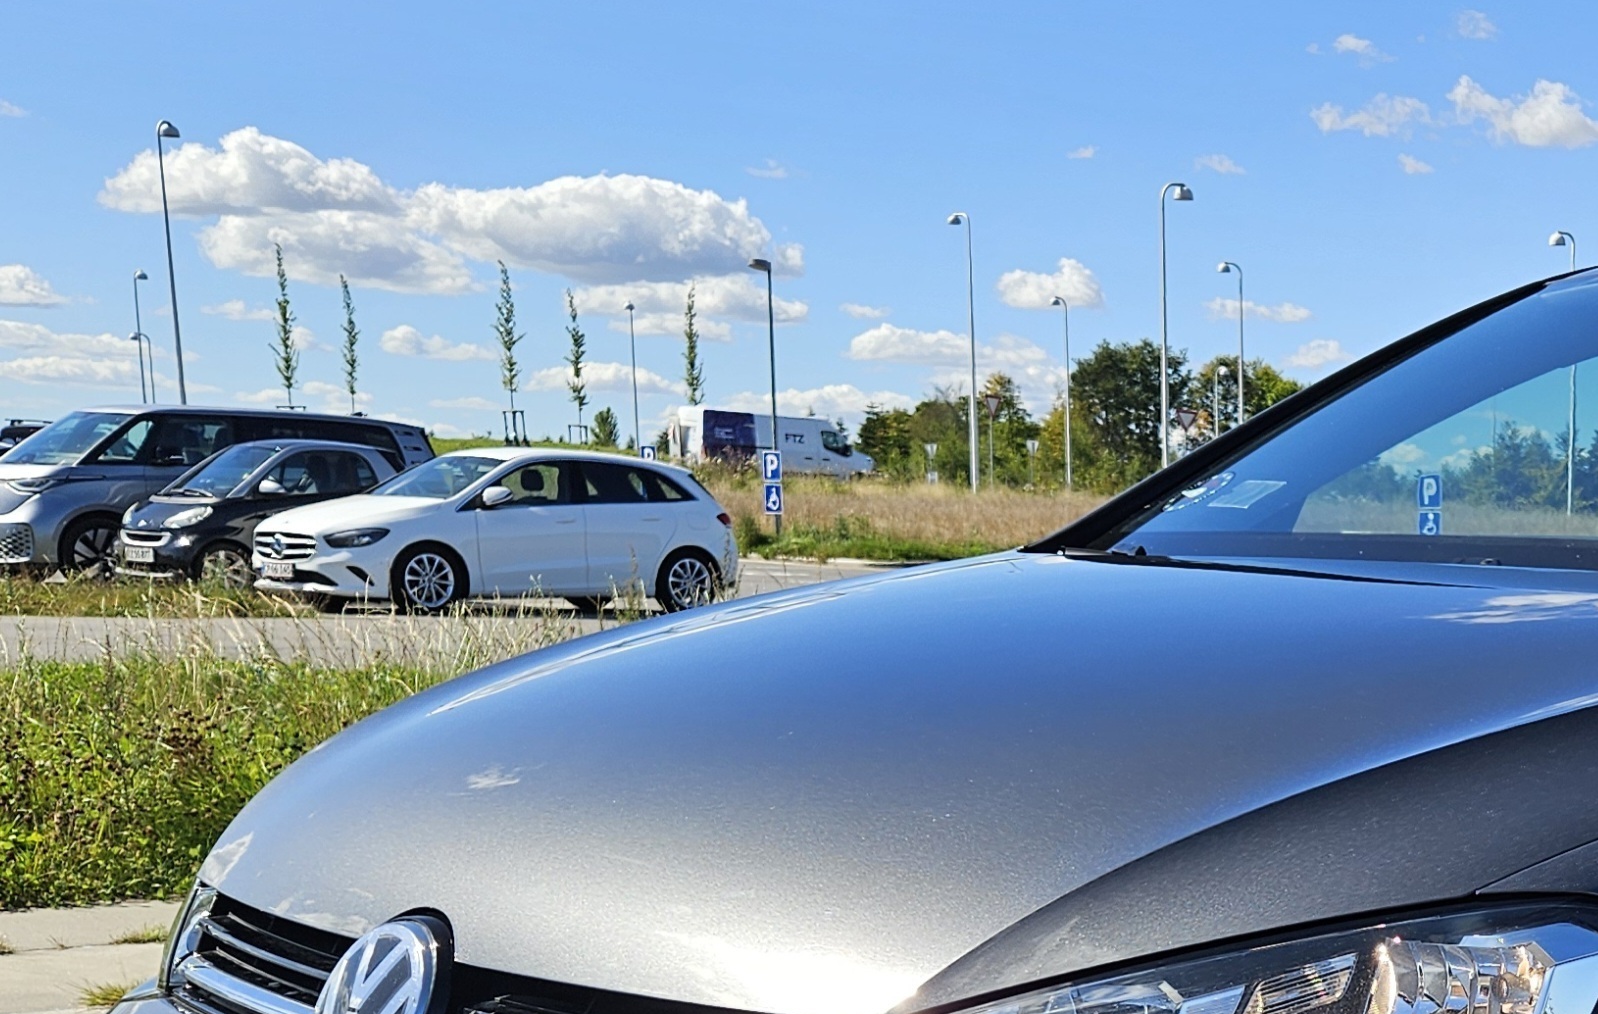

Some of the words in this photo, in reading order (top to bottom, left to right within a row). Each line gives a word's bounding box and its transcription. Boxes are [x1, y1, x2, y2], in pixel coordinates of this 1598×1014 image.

[784, 433, 805, 444] FTZ
[766, 454, 778, 478] P
[1423, 477, 1437, 505] P
